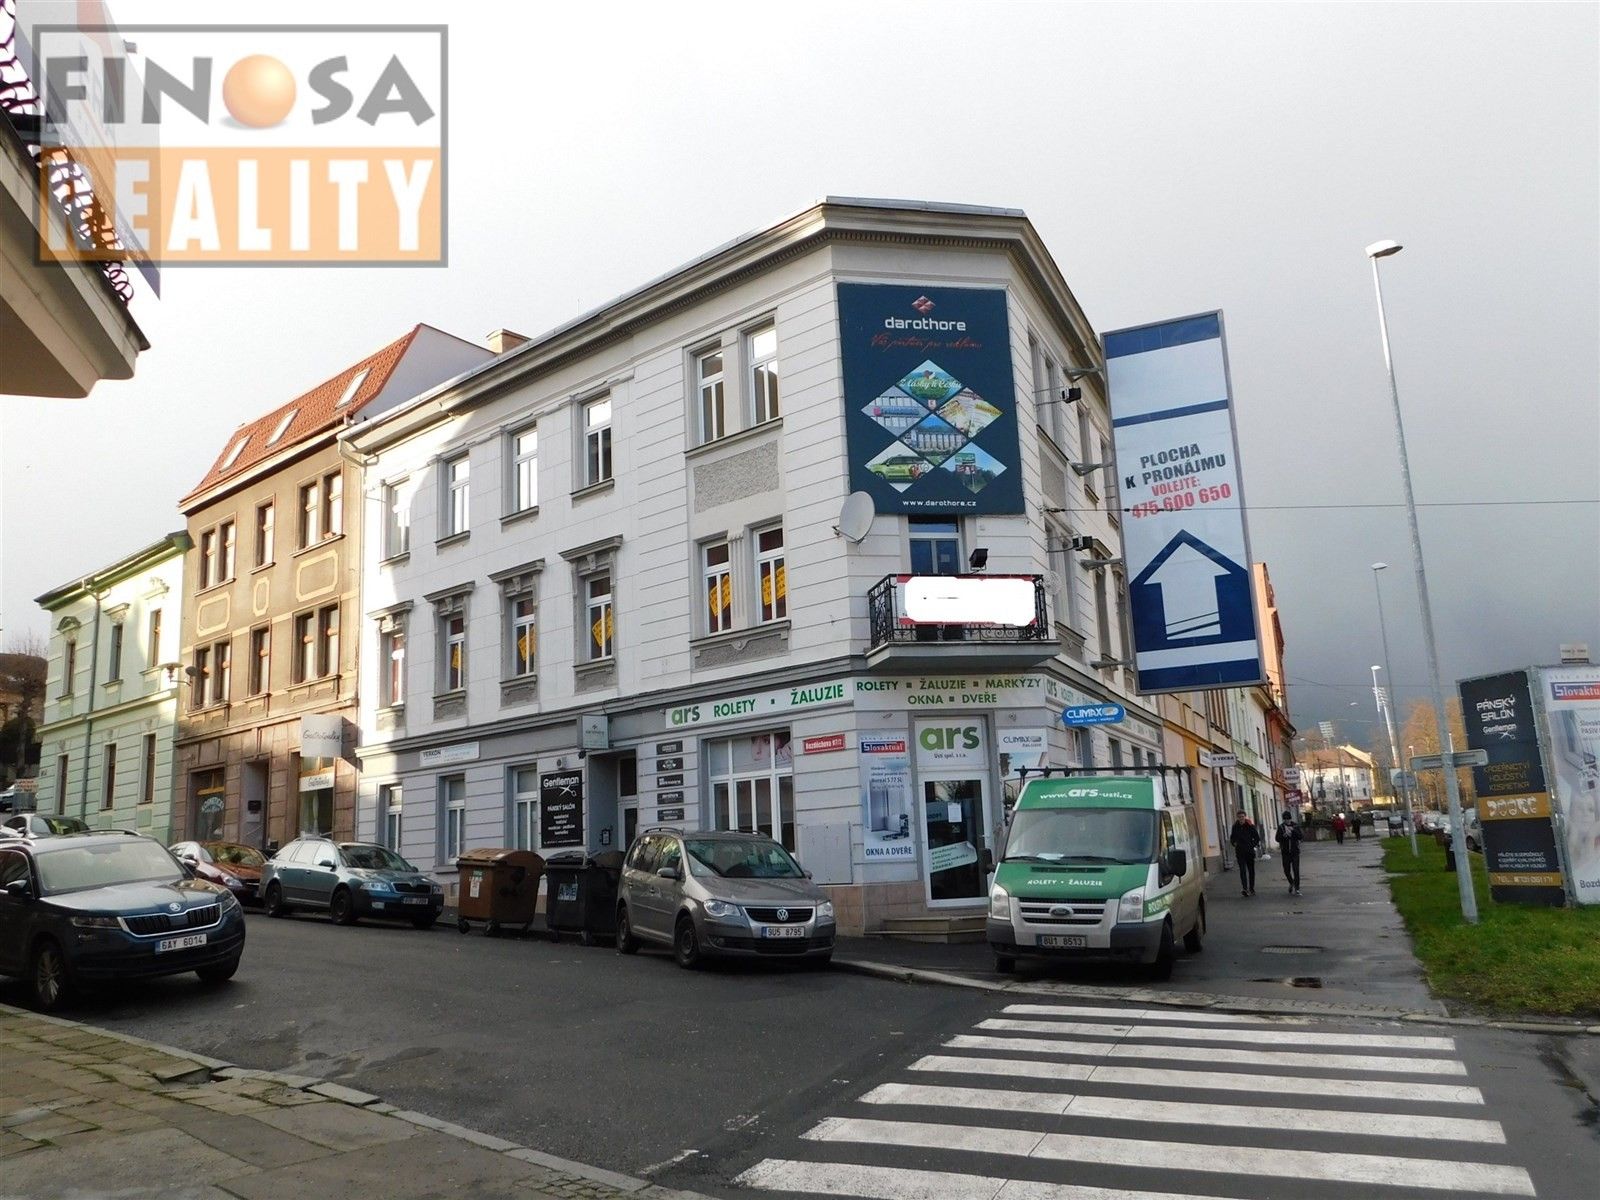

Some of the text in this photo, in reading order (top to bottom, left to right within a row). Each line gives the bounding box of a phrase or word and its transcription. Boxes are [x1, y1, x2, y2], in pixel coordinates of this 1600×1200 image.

[885, 317, 966, 331] darothore
[1139, 443, 1201, 469] PLOCHA
[1125, 453, 1227, 490] K PRONÁJMU
[1151, 477, 1202, 498] VOLEJTE:
[902, 499, 977, 508] www.darothore.cz
[1131, 483, 1232, 520] 475 600 650
[856, 677, 1042, 692] ROLETY ŽALUZIE MARKÝZY
[671, 684, 844, 726] ars ROLETY ŽALUZIE
[907, 691, 998, 705] OKNA DVEŘE
[1476, 693, 1516, 712] PÁNSKÝ
[1066, 707, 1103, 719] CLIMAX
[919, 725, 981, 751] ars
[1002, 735, 1030, 744] CLIMAX
[543, 776, 580, 788] Gentleman
[1040, 788, 1133, 800] www.ars-usti.cz
[866, 848, 885, 856] OKNA
[892, 845, 913, 855] DVEŘE
[1068, 878, 1103, 887] ŽALUZIE
